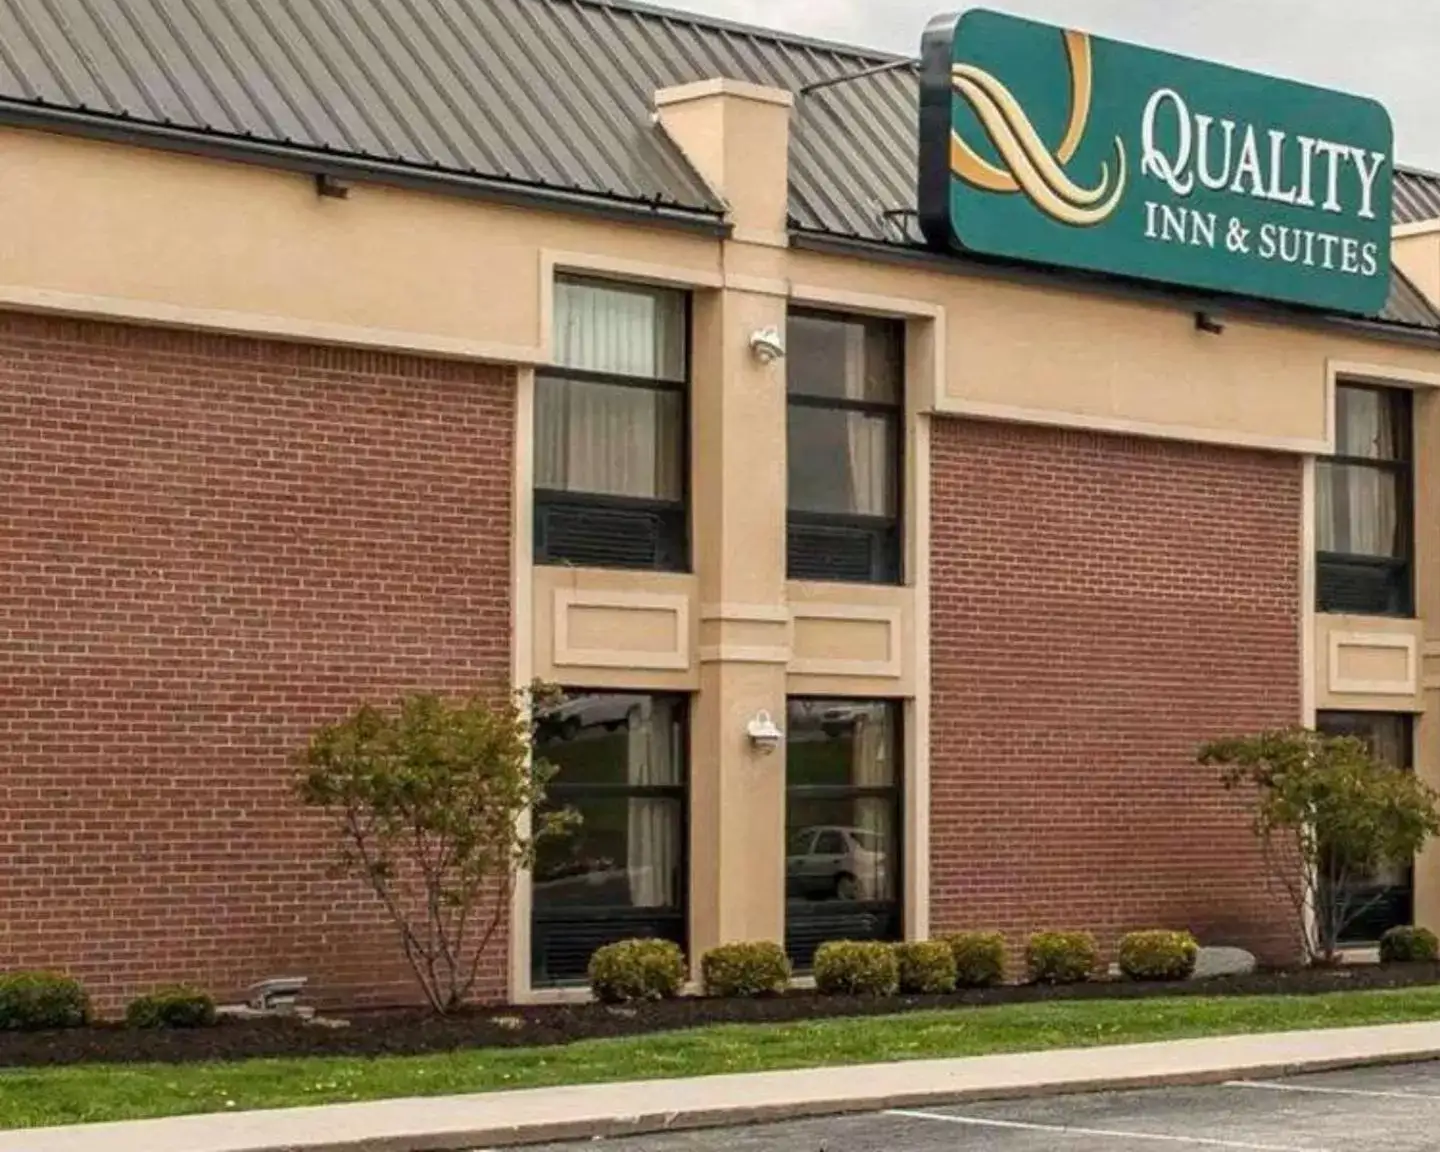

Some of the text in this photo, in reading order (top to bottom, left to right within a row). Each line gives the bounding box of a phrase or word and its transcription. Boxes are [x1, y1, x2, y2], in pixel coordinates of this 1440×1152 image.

[1141, 87, 1386, 219] QUALITY
[1144, 201, 1377, 277] INN & SUITES
